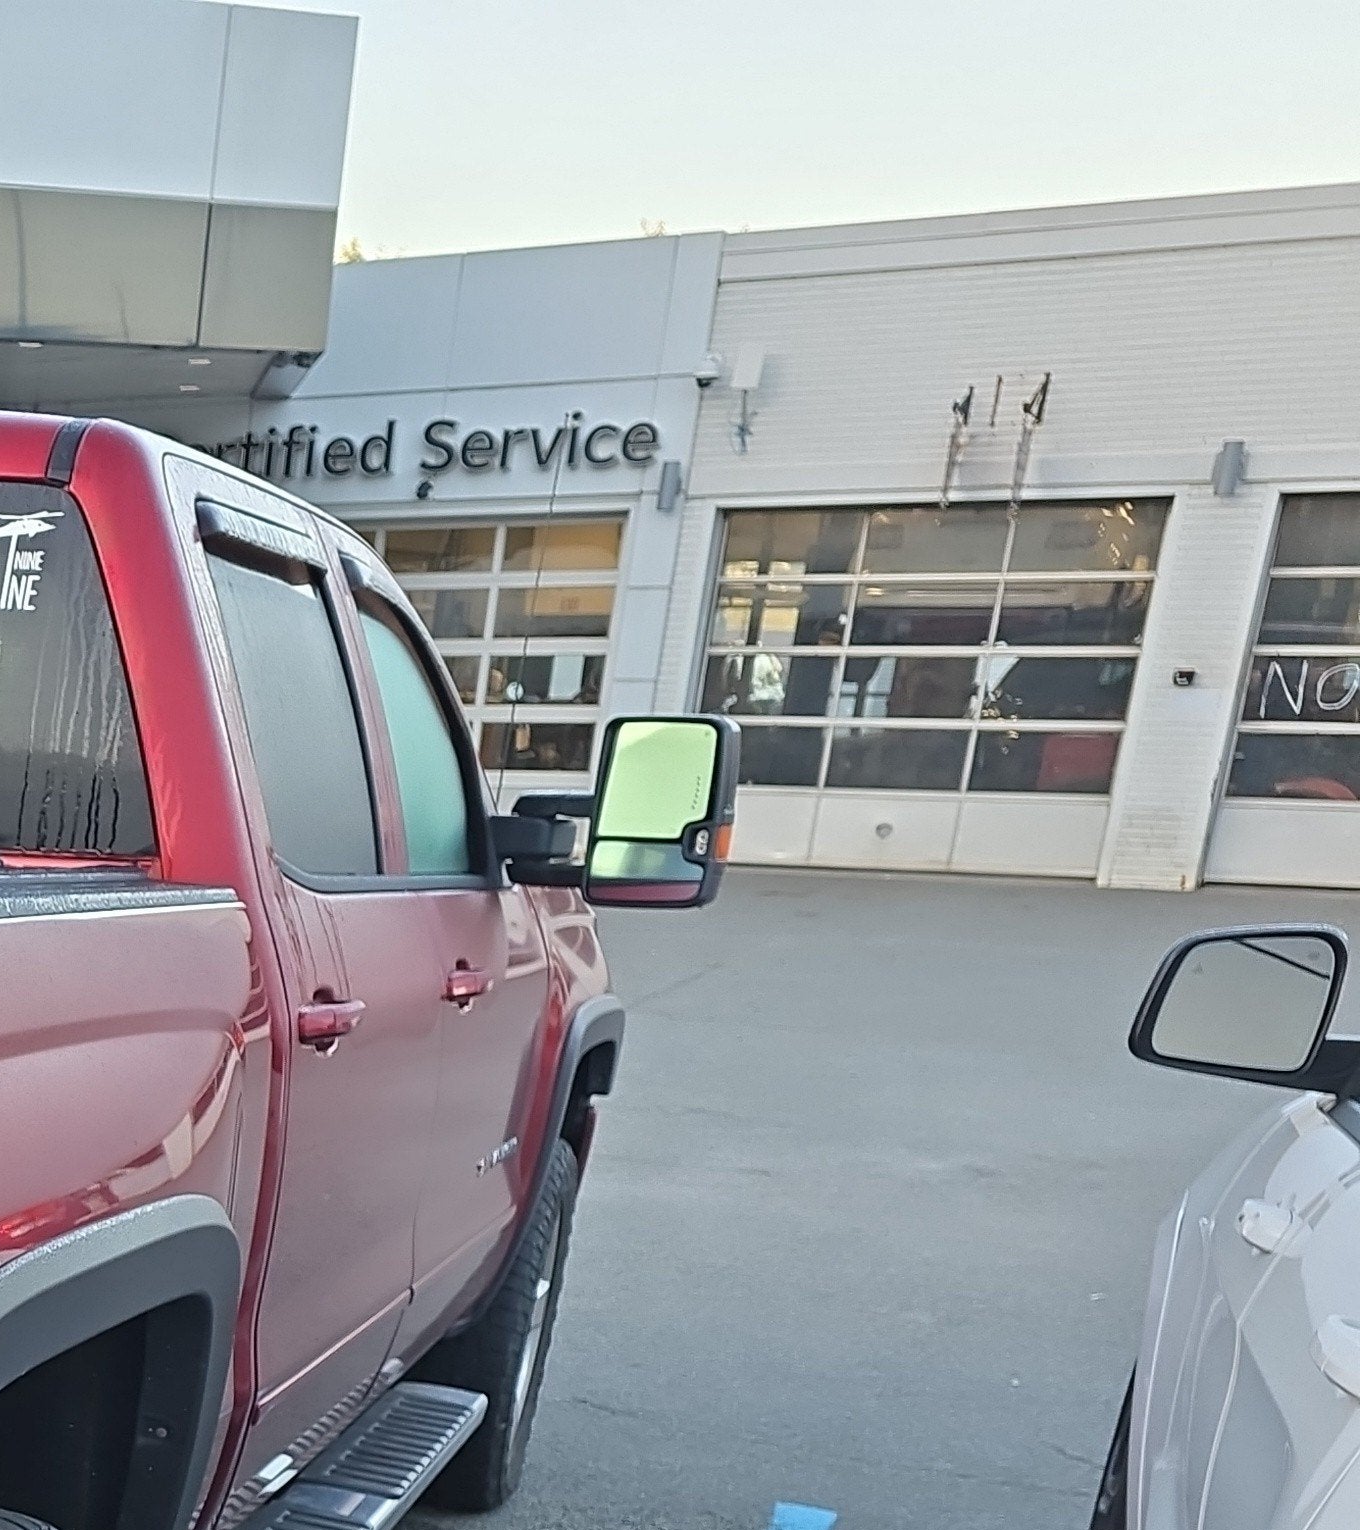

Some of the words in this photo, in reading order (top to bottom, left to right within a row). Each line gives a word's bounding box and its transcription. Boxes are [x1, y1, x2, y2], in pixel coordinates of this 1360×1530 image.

[191, 419, 396, 477] rtified
[420, 411, 659, 473] Service
[14, 551, 45, 570] NINE
[1259, 660, 1360, 718] NO
